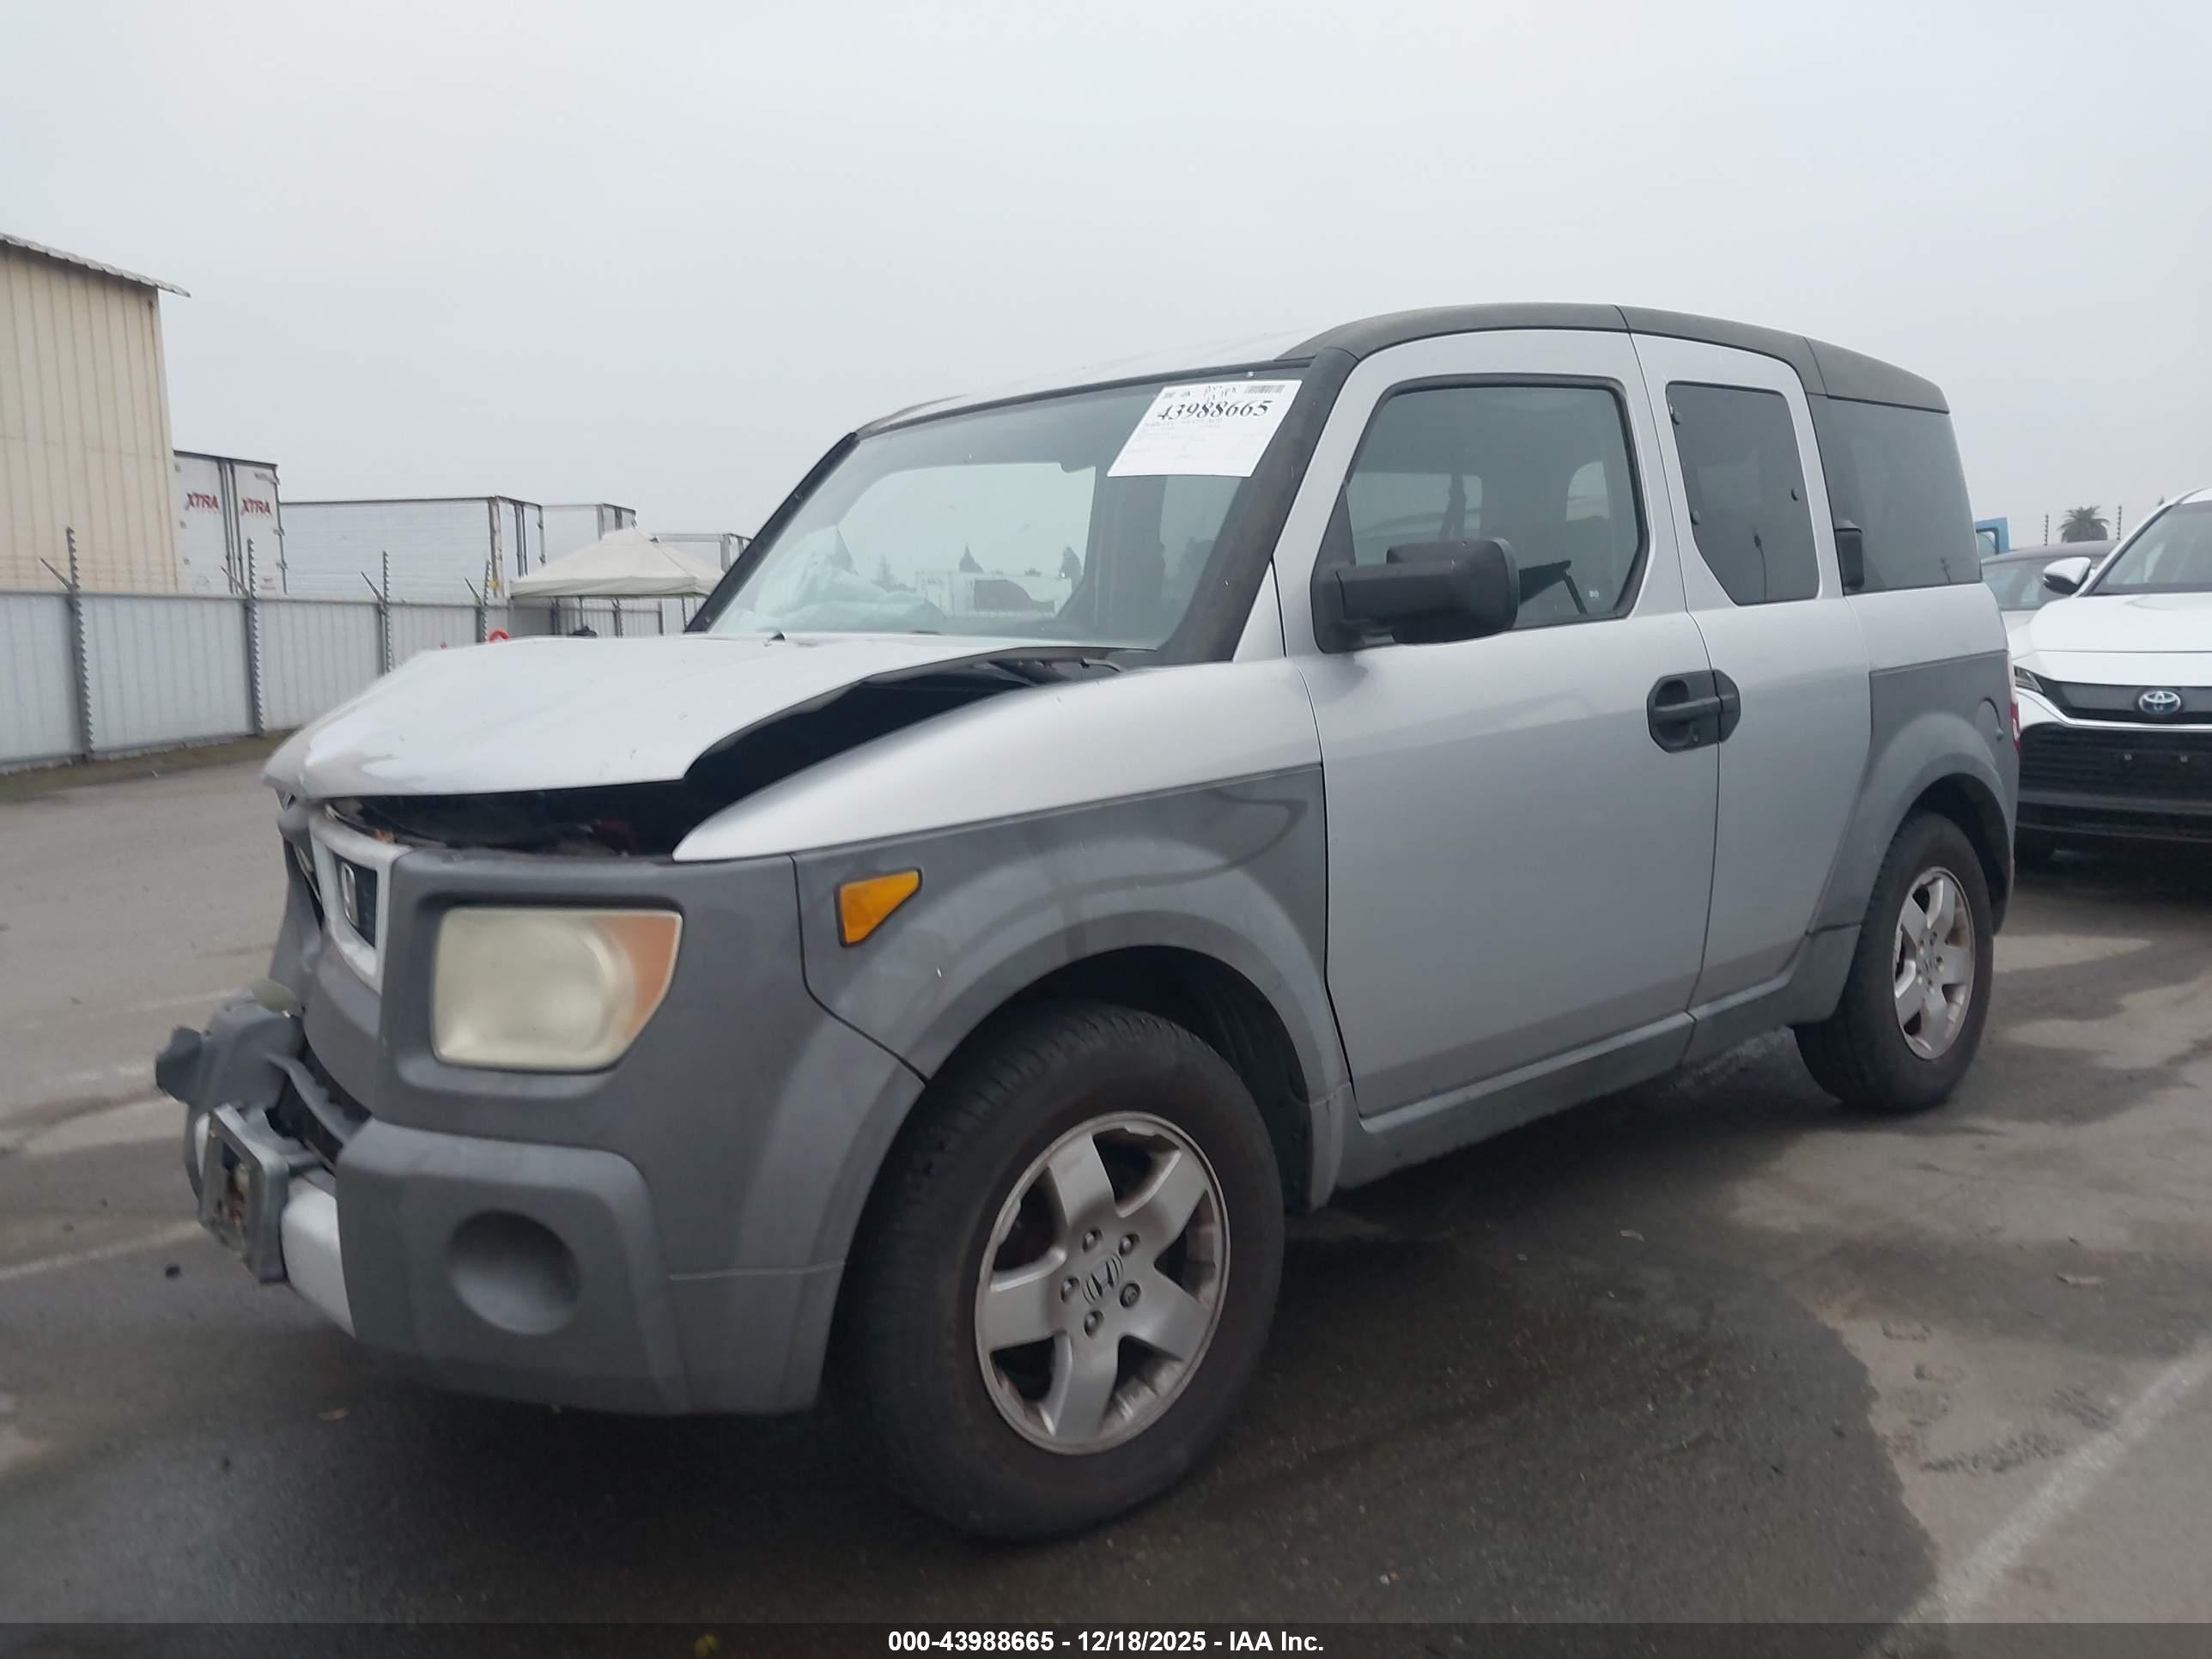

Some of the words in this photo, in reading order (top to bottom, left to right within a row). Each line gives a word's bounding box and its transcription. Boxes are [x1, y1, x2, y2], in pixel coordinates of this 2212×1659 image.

[1158, 400, 1273, 420] 43988665
[185, 492, 220, 510] XTRA
[241, 498, 272, 515] XTRA
